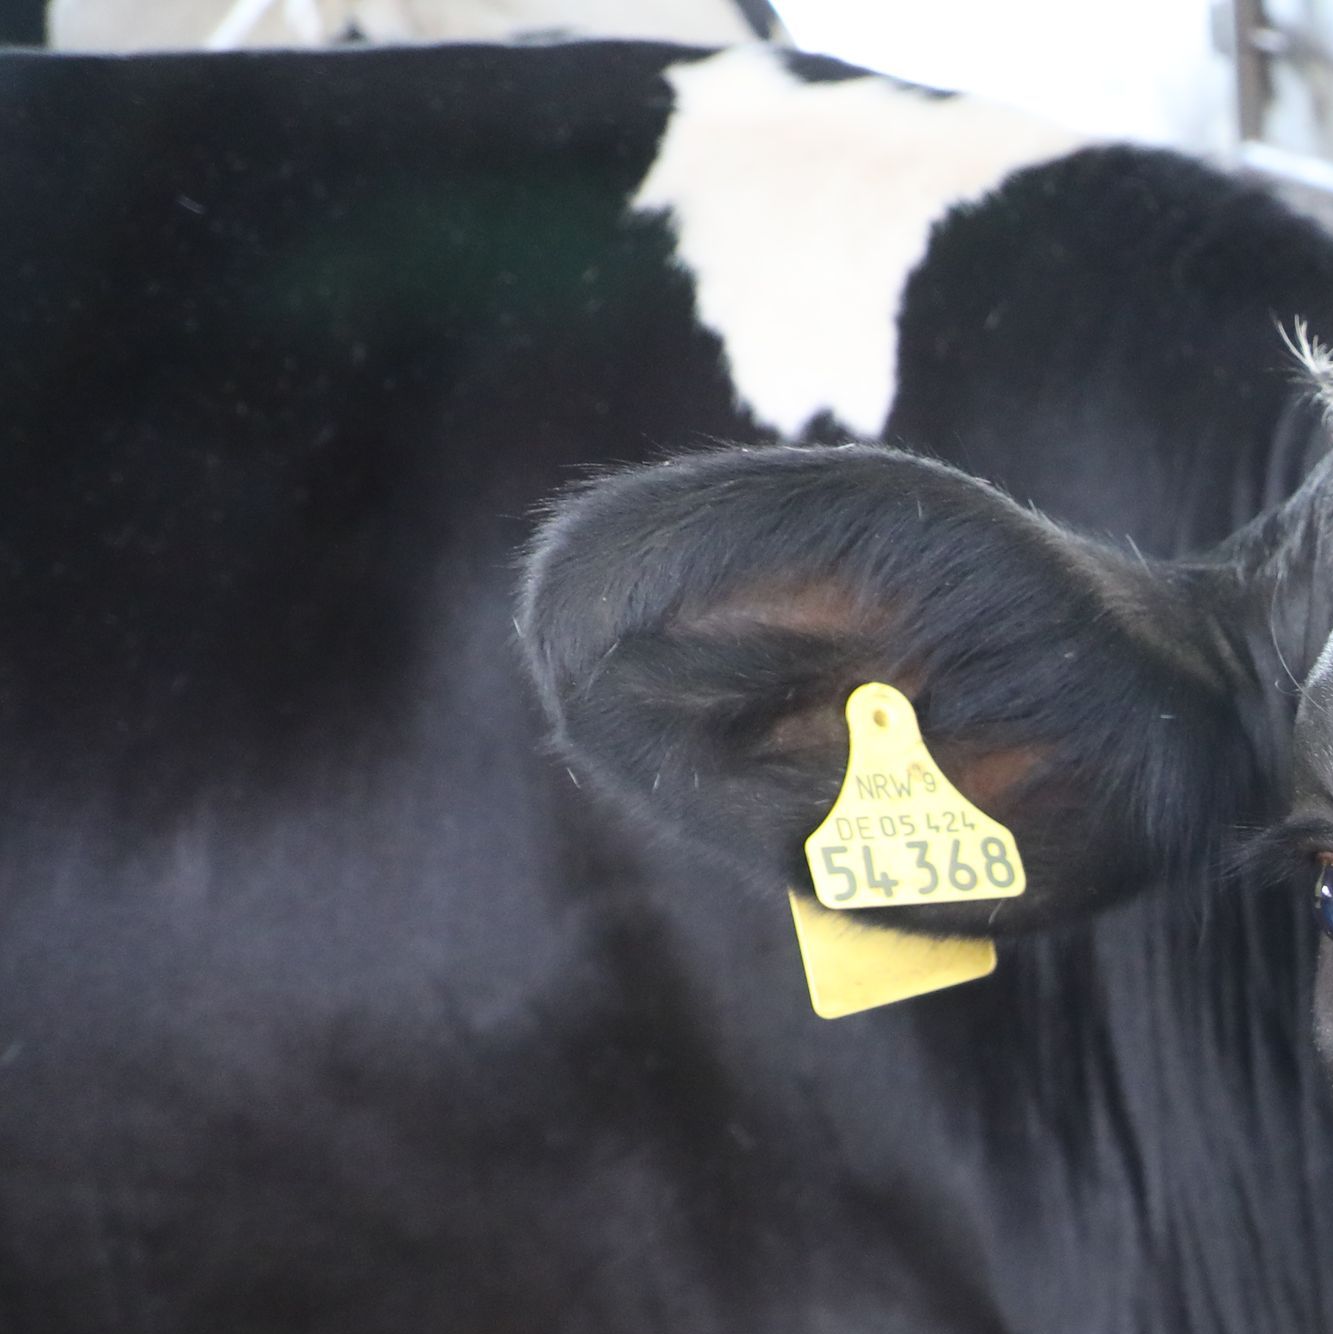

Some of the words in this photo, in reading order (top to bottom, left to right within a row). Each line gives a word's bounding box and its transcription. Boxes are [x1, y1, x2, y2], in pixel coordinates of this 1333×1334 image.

[855, 769, 913, 800] NRW
[835, 816, 875, 841] DE
[879, 814, 916, 837] 05
[925, 810, 976, 833] 424
